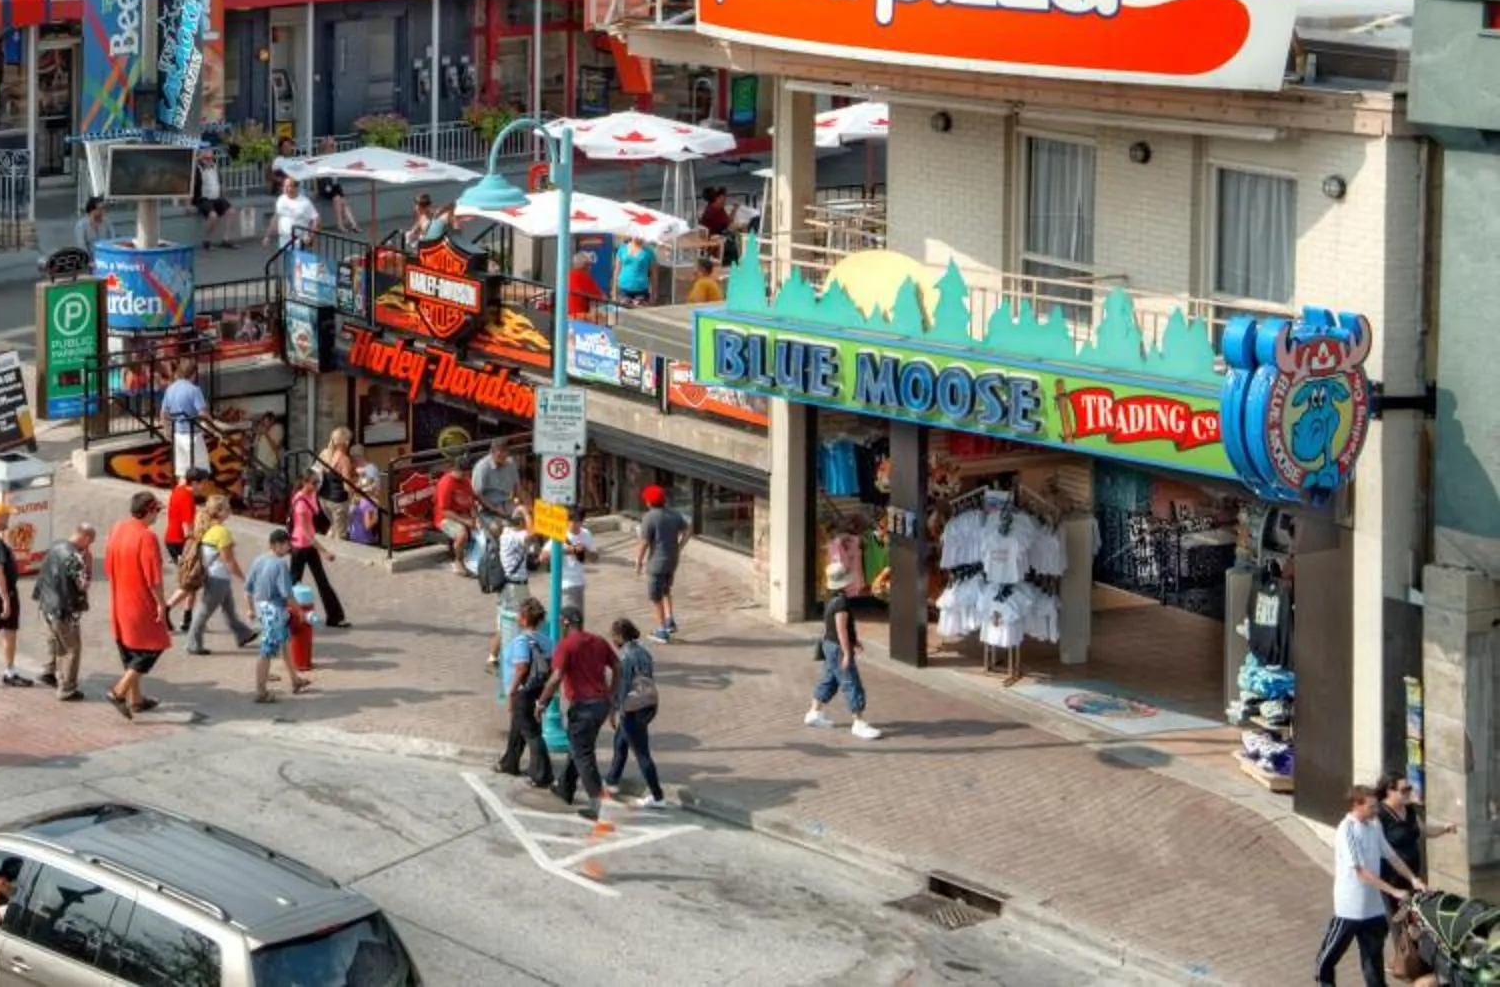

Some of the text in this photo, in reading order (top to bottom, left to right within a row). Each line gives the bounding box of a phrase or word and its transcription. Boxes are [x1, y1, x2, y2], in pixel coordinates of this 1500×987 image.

[64, 301, 83, 329] P
[107, 291, 162, 315] rden
[51, 335, 94, 350] PUBLIC
[714, 326, 841, 397] BLUE
[854, 348, 1043, 433] MOOSE
[1081, 393, 1186, 435] TRADING
[1269, 429, 1301, 485] MOOSE
